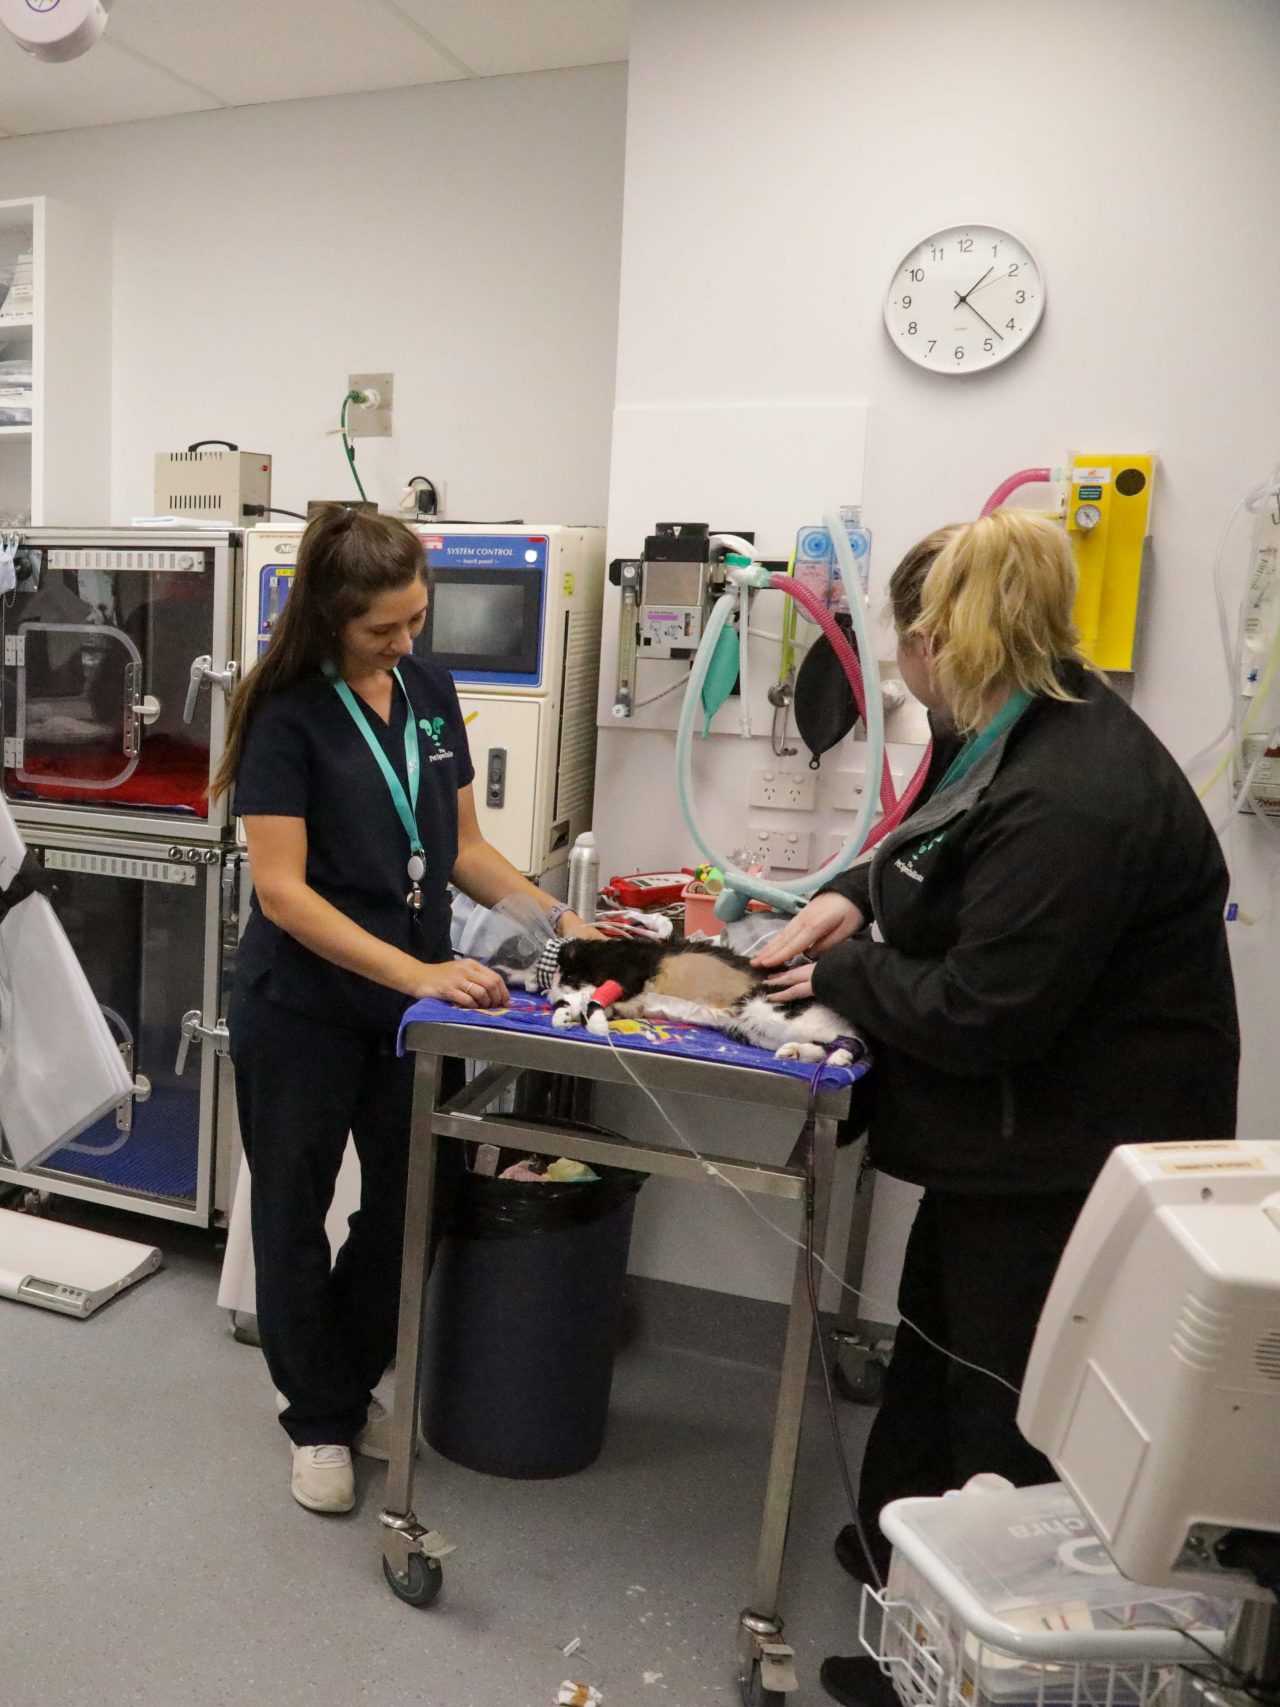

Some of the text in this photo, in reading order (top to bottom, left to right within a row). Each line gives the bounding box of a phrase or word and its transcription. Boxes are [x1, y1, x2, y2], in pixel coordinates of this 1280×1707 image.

[957, 239, 974, 253] 12
[991, 245, 997, 258] 1
[931, 248, 944, 261] 11
[909, 268, 925, 282] 10
[1008, 264, 1019, 277] 2
[902, 296, 912, 309] 9
[1015, 290, 1025, 304] 3
[908, 322, 918, 335] 8
[1005, 318, 1016, 330] 4
[928, 340, 937, 353] 7
[983, 338, 993, 351] 5
[954, 346, 964, 360] 6
[447, 547, 513, 556] SYSTEM CONTROL
